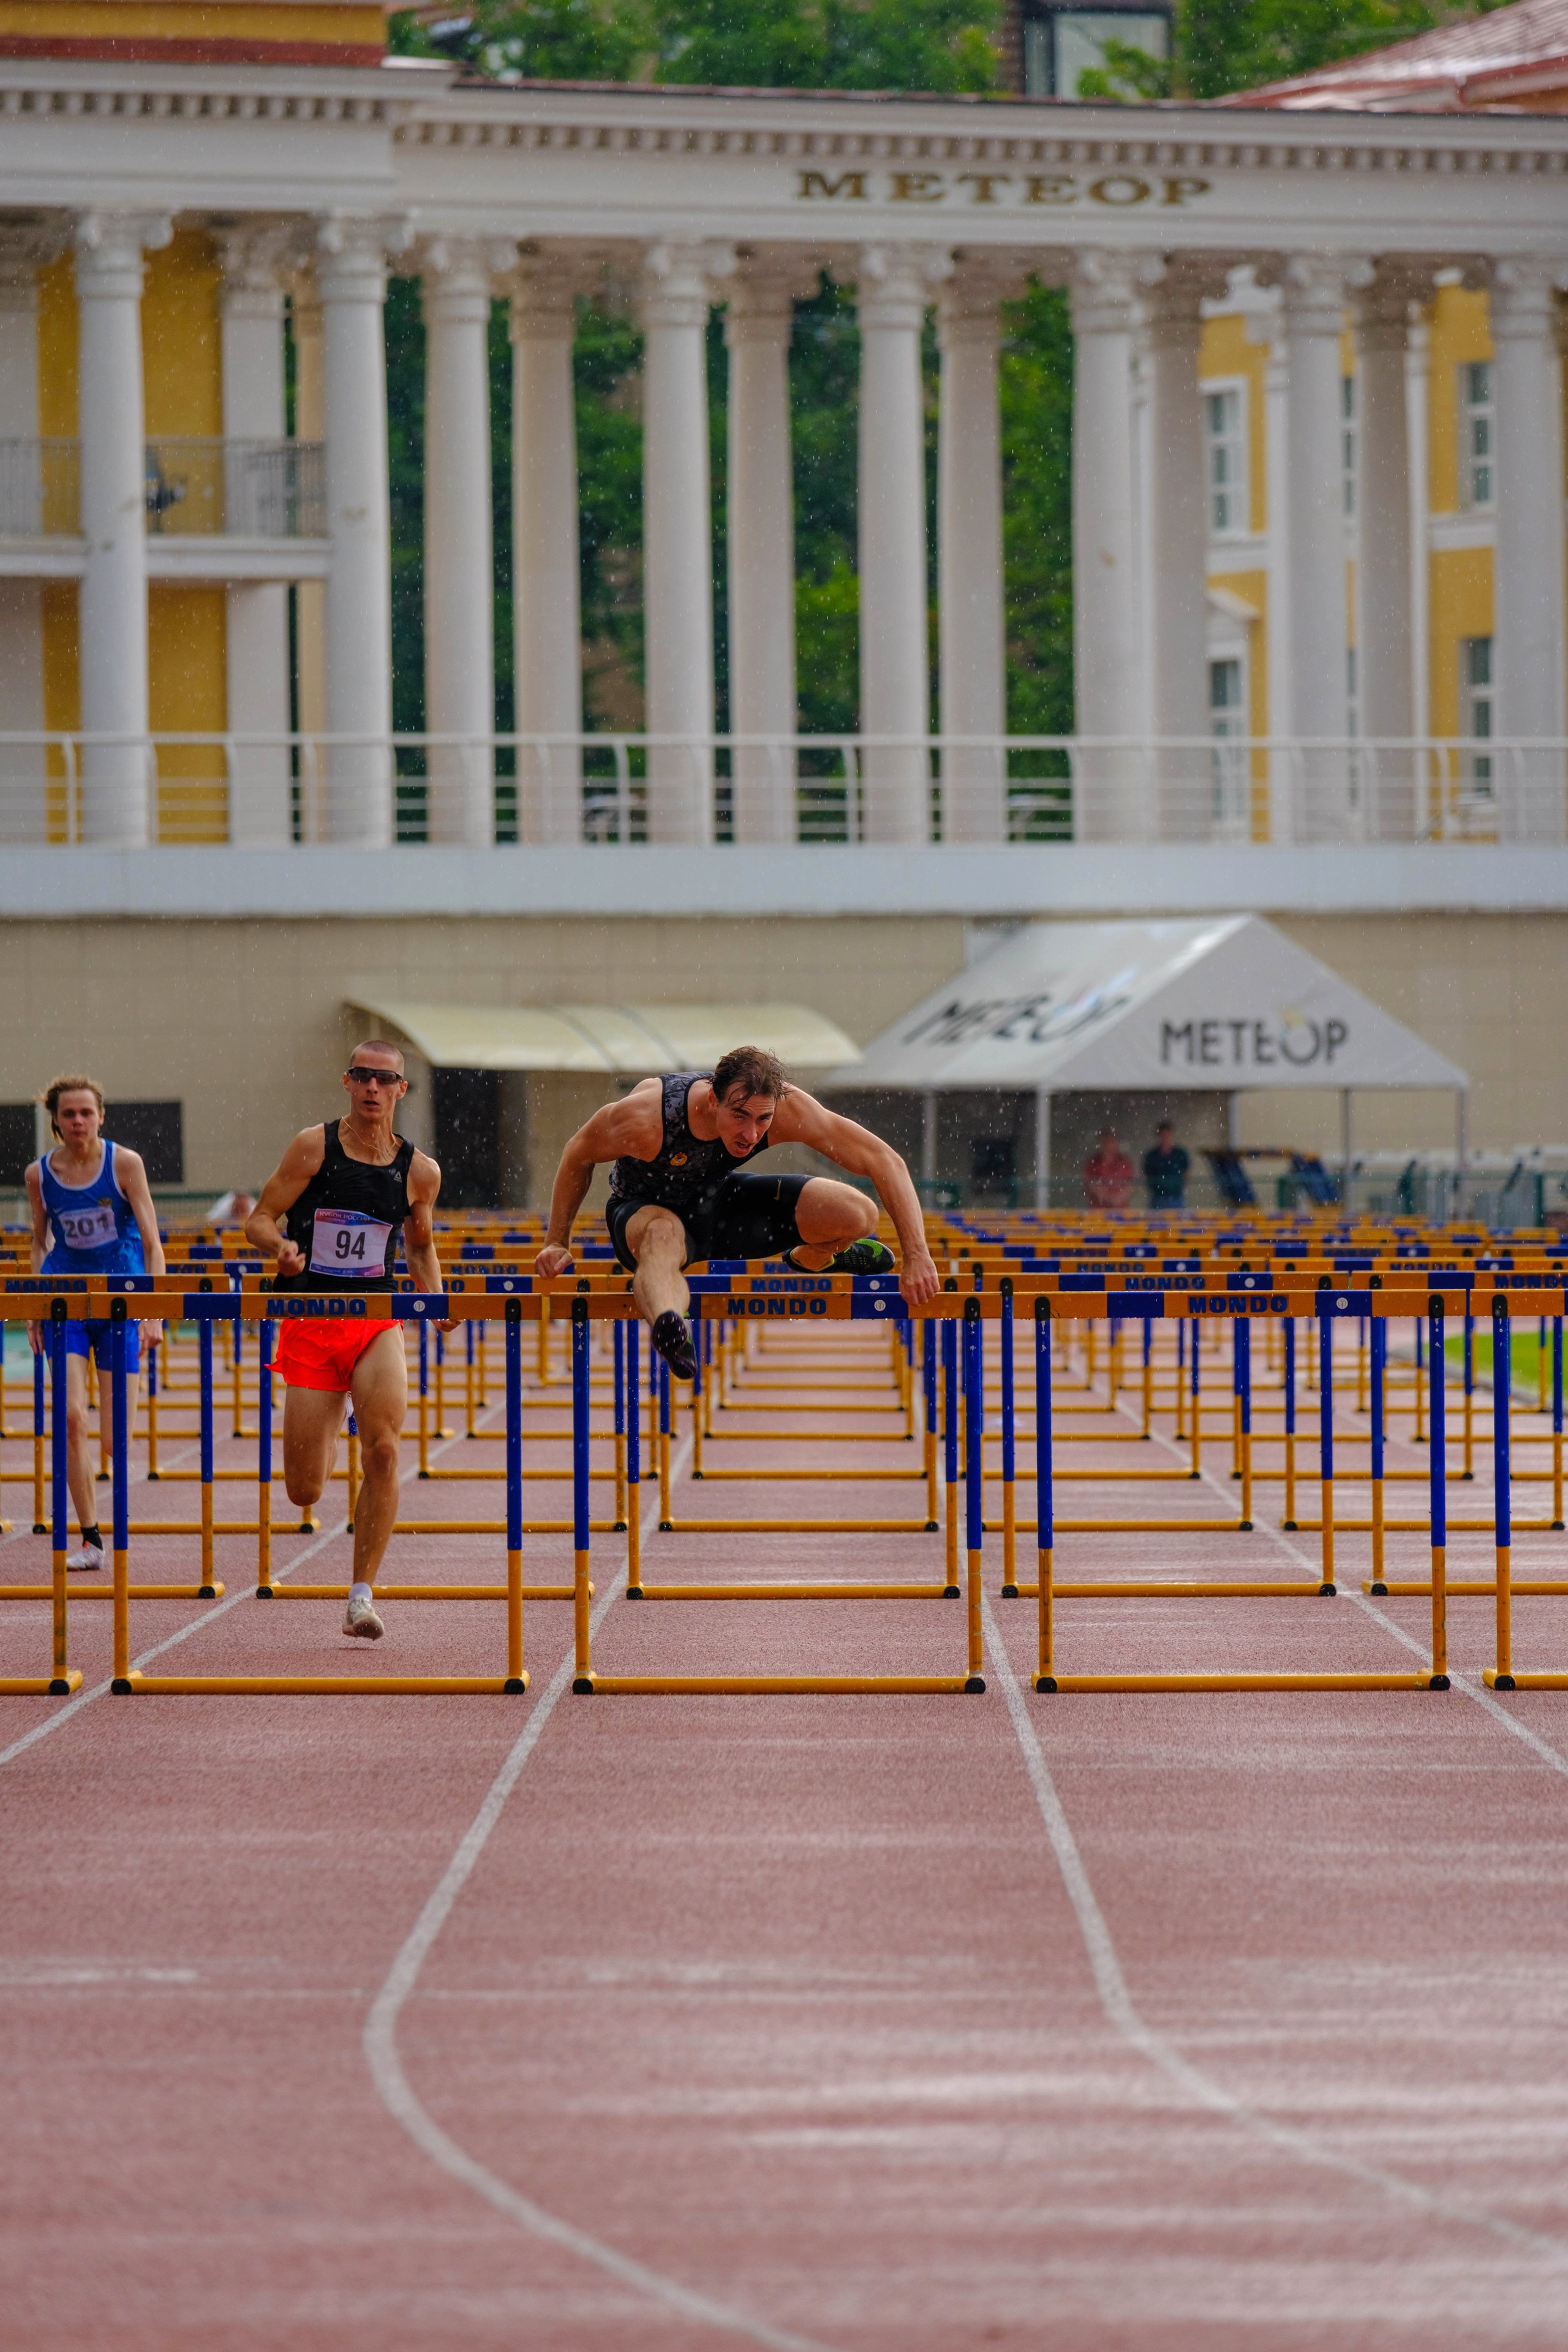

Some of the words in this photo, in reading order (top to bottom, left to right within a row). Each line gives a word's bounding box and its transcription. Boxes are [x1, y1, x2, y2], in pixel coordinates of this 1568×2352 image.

[797, 172, 1211, 206] МЕТЕОР
[1159, 1012, 1350, 1066] МЕТЕОР
[64, 1213, 109, 1238] 201
[335, 1230, 366, 1260] 94
[6, 1279, 87, 1292] MONDO
[752, 1279, 831, 1292] MONDO
[1125, 1277, 1205, 1290] MONDO
[267, 1298, 366, 1315] MONDO
[728, 1298, 826, 1315] MONDO
[1189, 1296, 1287, 1313] MONDO
